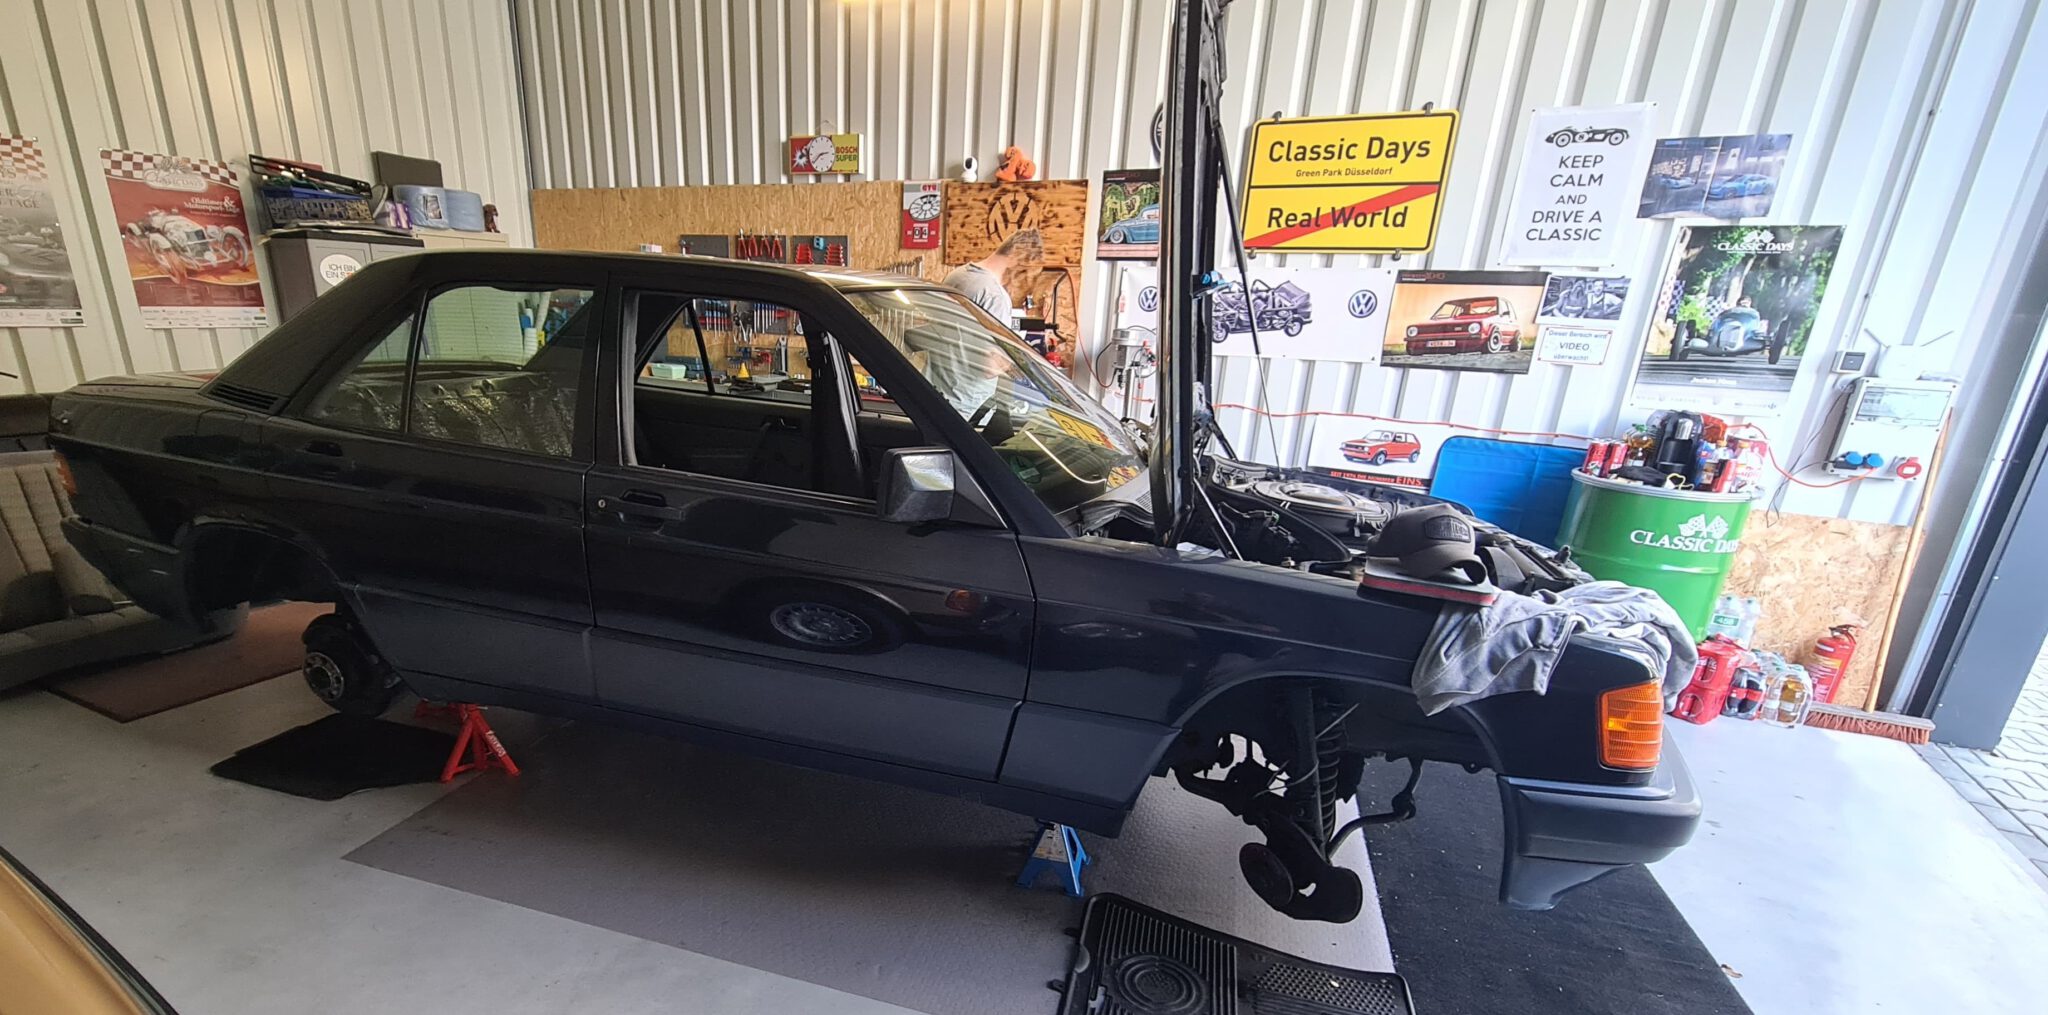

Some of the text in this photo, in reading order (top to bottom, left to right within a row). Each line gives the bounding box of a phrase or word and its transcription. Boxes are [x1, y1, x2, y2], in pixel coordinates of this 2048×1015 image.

[835, 146, 857, 154] BOSCH
[1269, 136, 1431, 164] Classic Days
[836, 154, 857, 162] SUPER
[1558, 154, 1604, 169] KEEP
[1296, 167, 1393, 178] Green Park Düsseldorf
[1550, 173, 1604, 188] CALM
[1555, 194, 1588, 205] AND
[1267, 206, 1408, 228] Real World
[1532, 210, 1602, 223] DRIVE A
[1526, 228, 1602, 241] CLASSIC
[1717, 242, 1795, 251] CLASSIC DAYS
[1569, 330, 1592, 338] Bereich
[1560, 341, 1590, 352] VIDEO
[1630, 529, 1713, 553] CLASSIC
